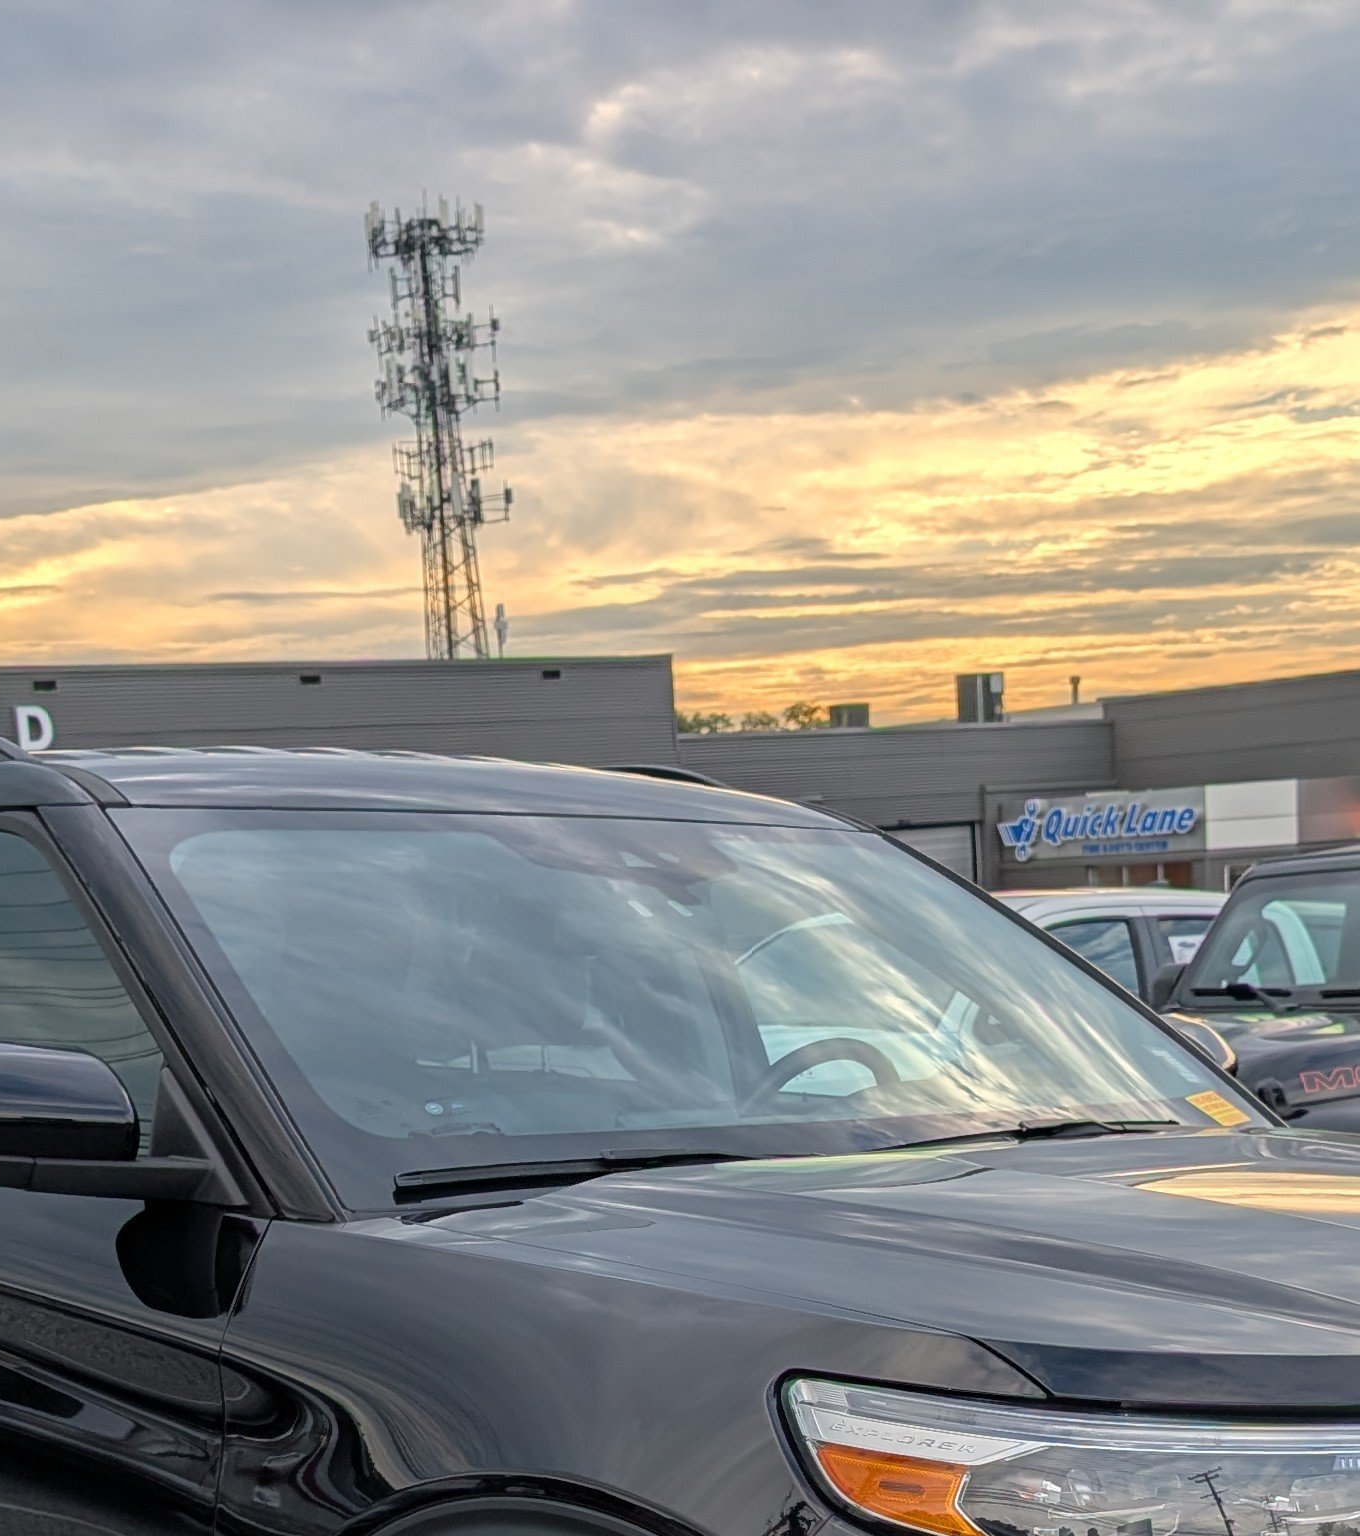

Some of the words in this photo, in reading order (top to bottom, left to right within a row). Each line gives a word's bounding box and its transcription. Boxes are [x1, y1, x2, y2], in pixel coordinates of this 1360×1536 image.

[1043, 803, 1119, 845] Quick
[1123, 802, 1196, 835] Lane
[829, 1421, 978, 1453] EXPLORER
